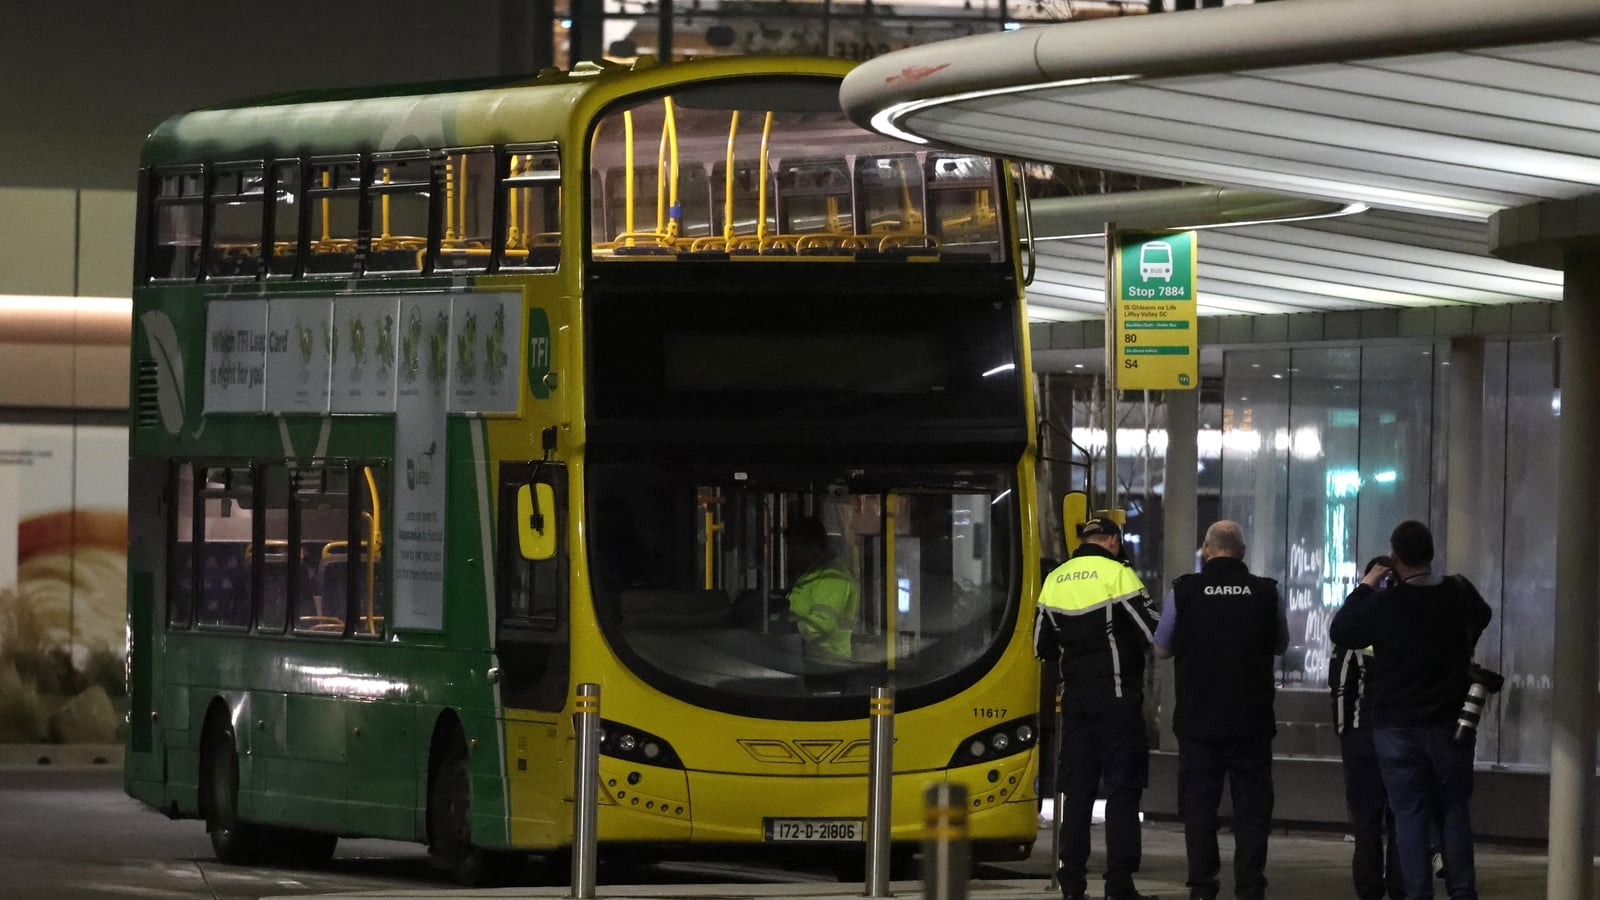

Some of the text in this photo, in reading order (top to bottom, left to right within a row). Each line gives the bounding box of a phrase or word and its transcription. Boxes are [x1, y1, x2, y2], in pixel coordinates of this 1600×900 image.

[1128, 286, 1185, 299] Stop 7884
[1124, 333, 1137, 343] 80
[531, 336, 549, 369] TFI
[1124, 359, 1138, 369] S4
[1056, 570, 1099, 584] GARDA
[1204, 585, 1252, 595] GARDA
[973, 707, 1007, 719] 11617
[780, 823, 855, 839] 172-D-21806
